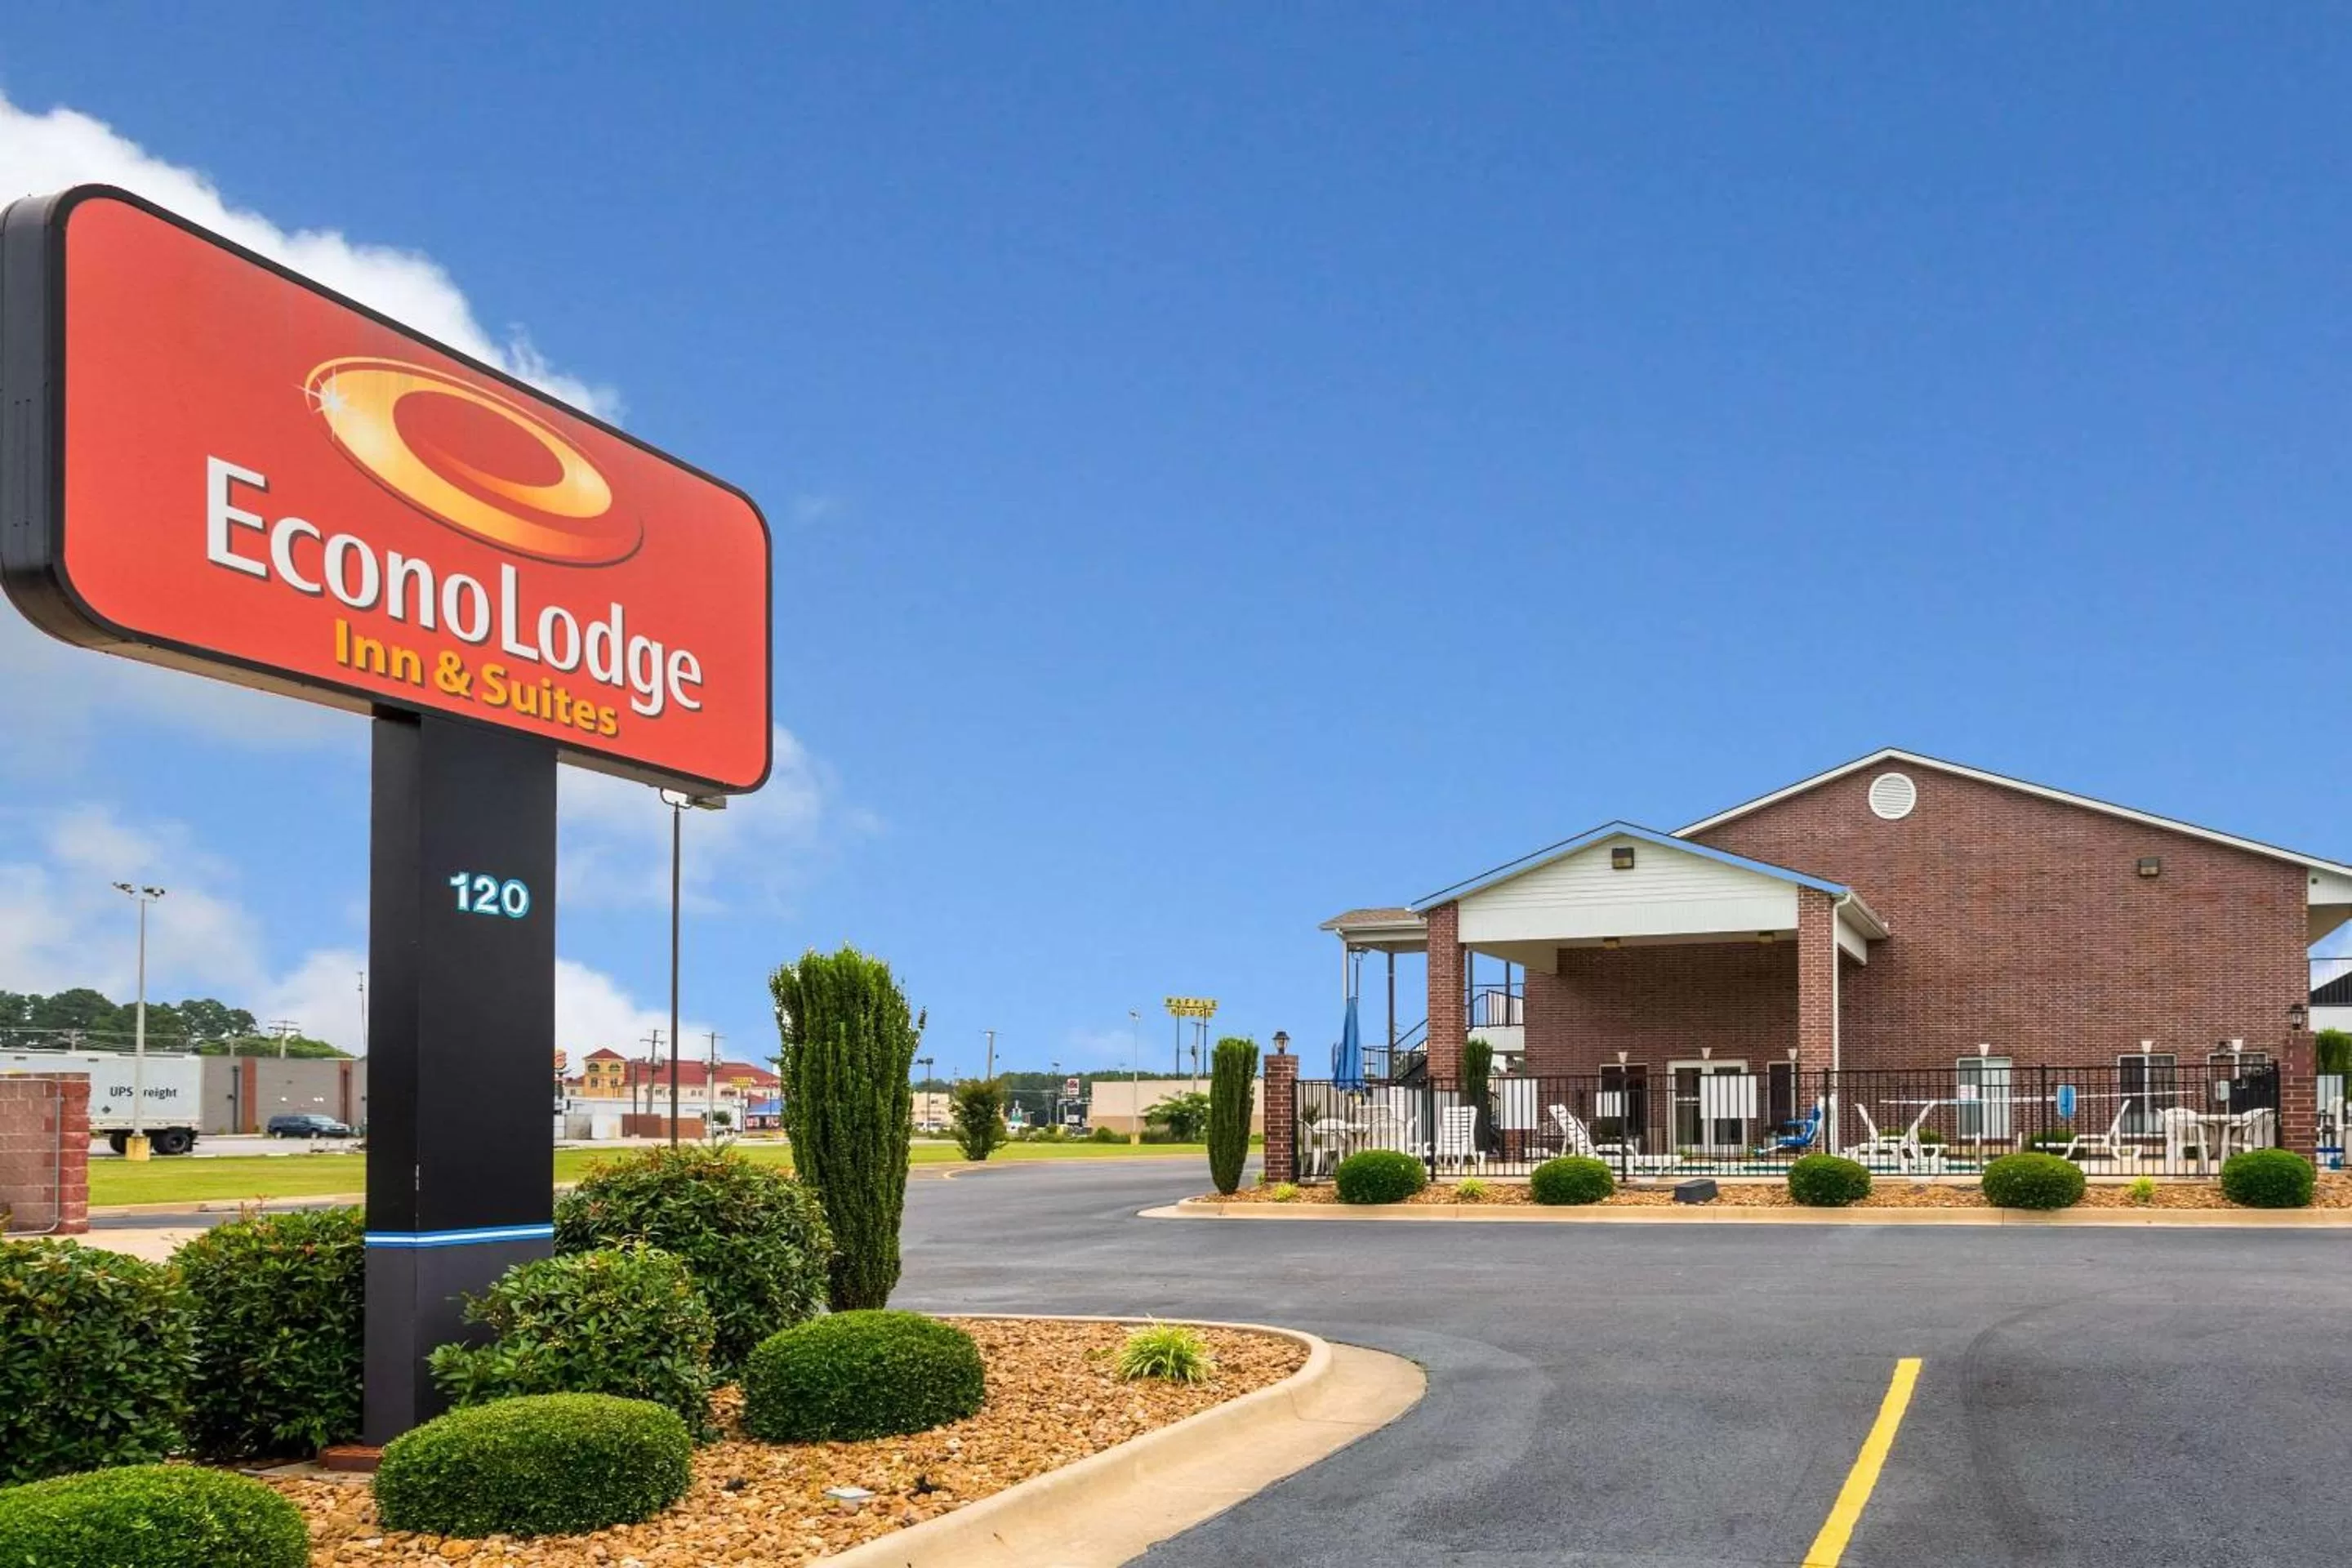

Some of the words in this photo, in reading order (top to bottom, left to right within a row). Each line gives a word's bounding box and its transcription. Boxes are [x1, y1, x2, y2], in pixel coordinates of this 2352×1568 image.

[334, 618, 425, 689] Inn
[433, 649, 474, 699] &
[480, 662, 619, 737] Suites
[449, 871, 530, 919] 120
[109, 1086, 134, 1098] UPS
[136, 1087, 177, 1100] reight
